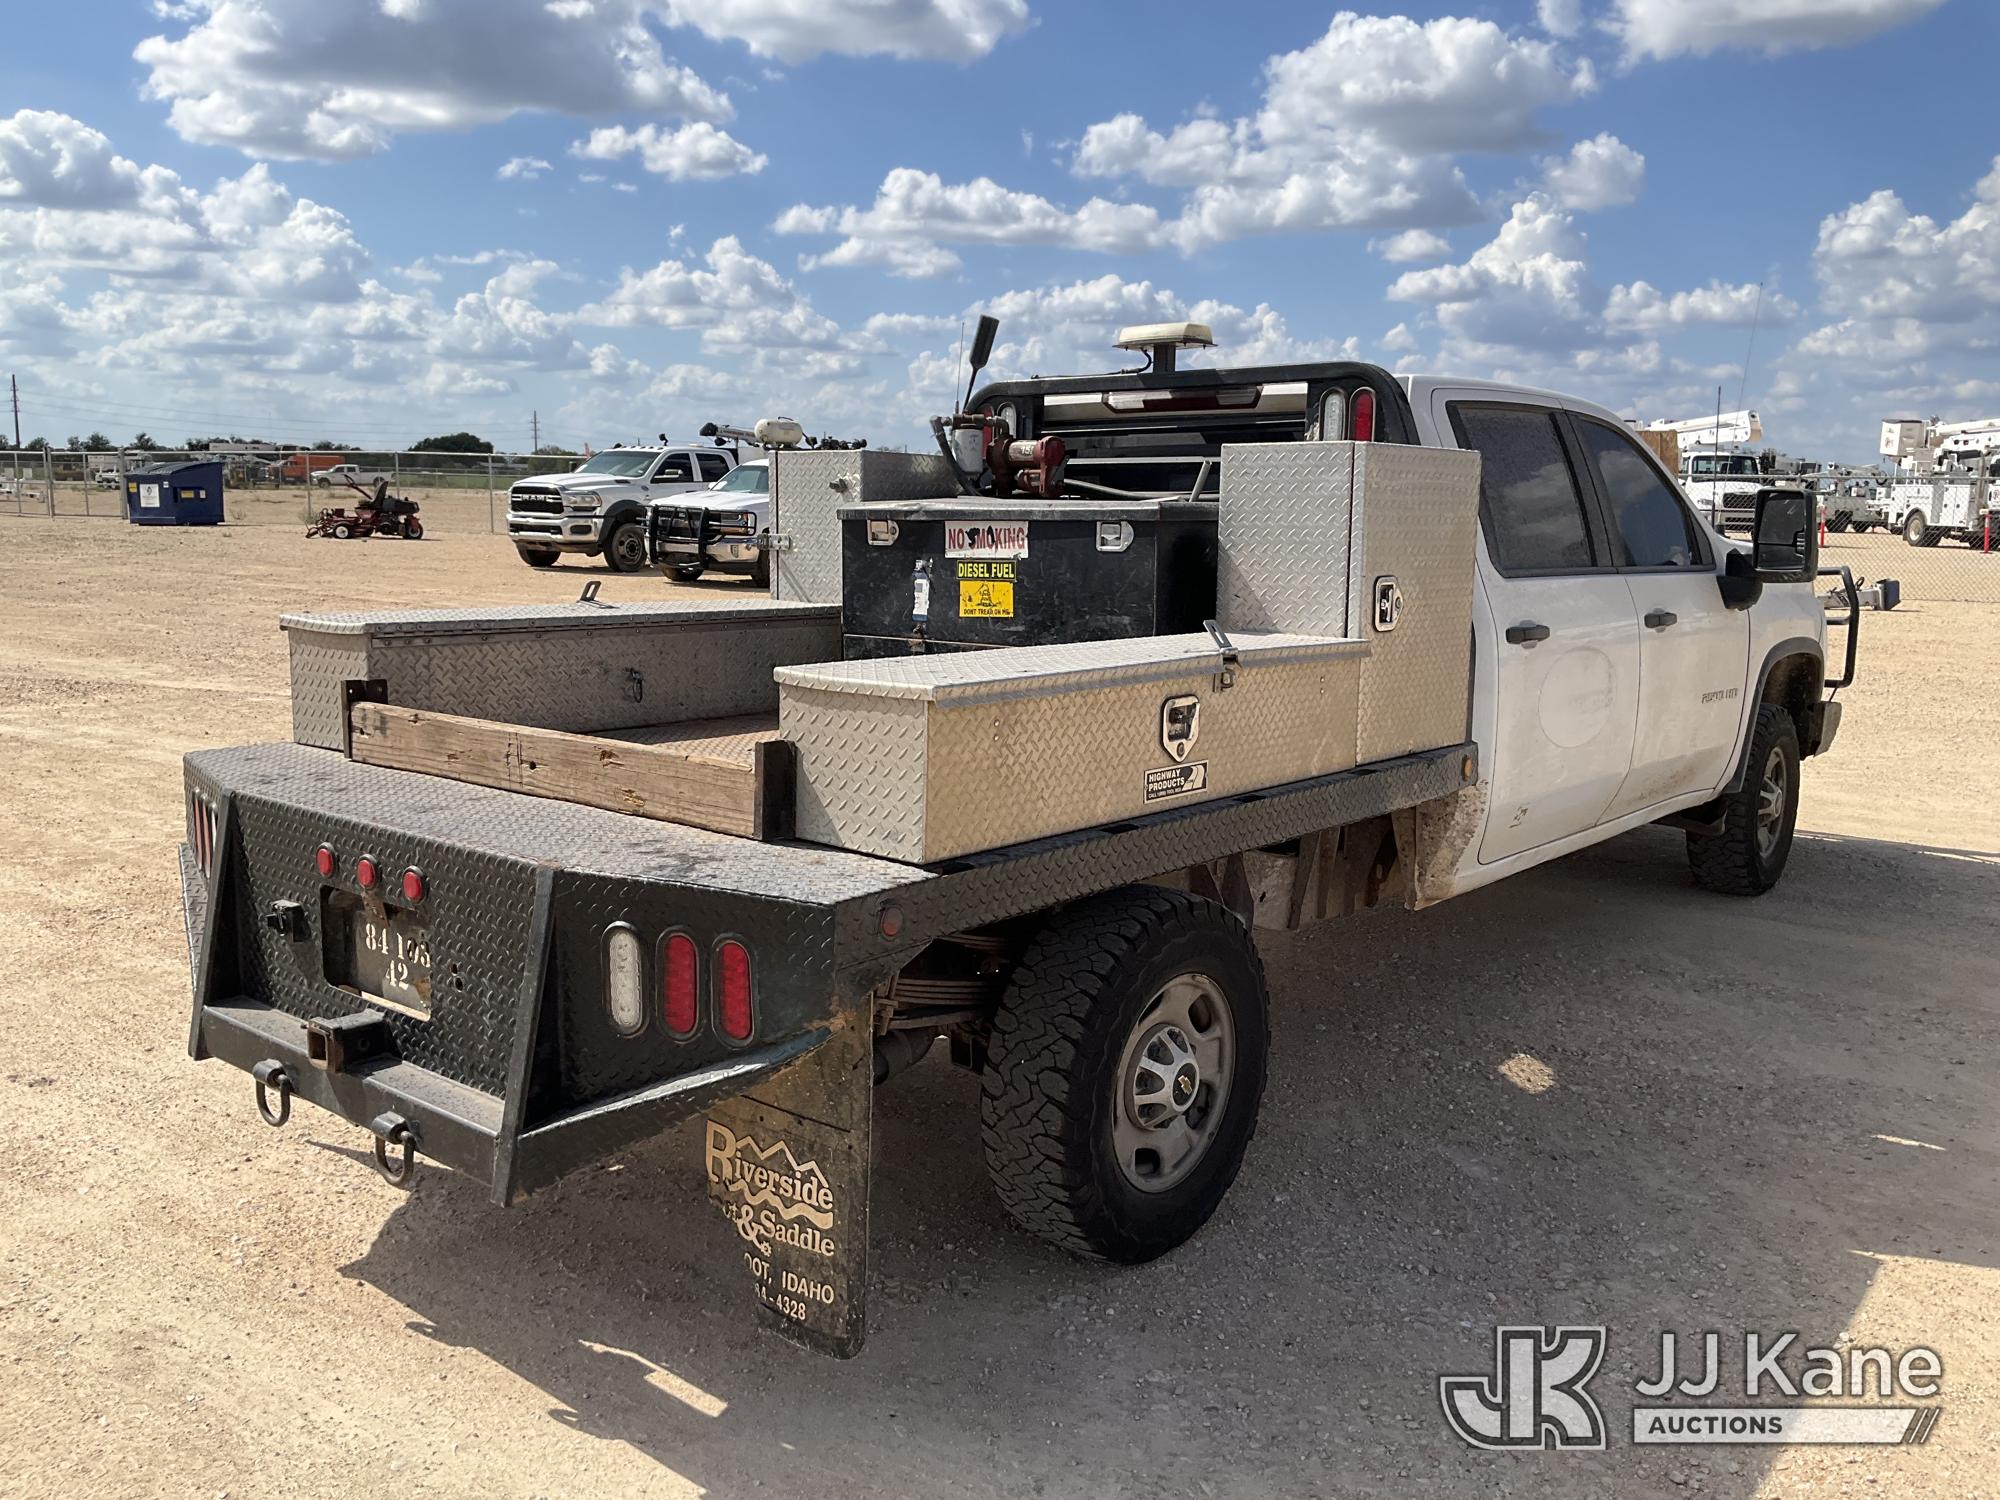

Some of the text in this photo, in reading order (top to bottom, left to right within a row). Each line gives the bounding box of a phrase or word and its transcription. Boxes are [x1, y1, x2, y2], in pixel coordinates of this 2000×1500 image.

[522, 494, 545, 502] RAM
[948, 527, 1026, 550] NO SMOKING
[958, 563, 1015, 578] DIESEL FUEL
[1148, 769, 1181, 783] HIGHWAY
[1148, 777, 1185, 792] PRODUCTS
[365, 923, 389, 955] 84
[385, 959, 409, 991] 42
[705, 1119, 834, 1210] Riverside
[736, 1204, 773, 1257] &
[760, 1209, 835, 1257] Saddle
[781, 1270, 835, 1305] IDAHO
